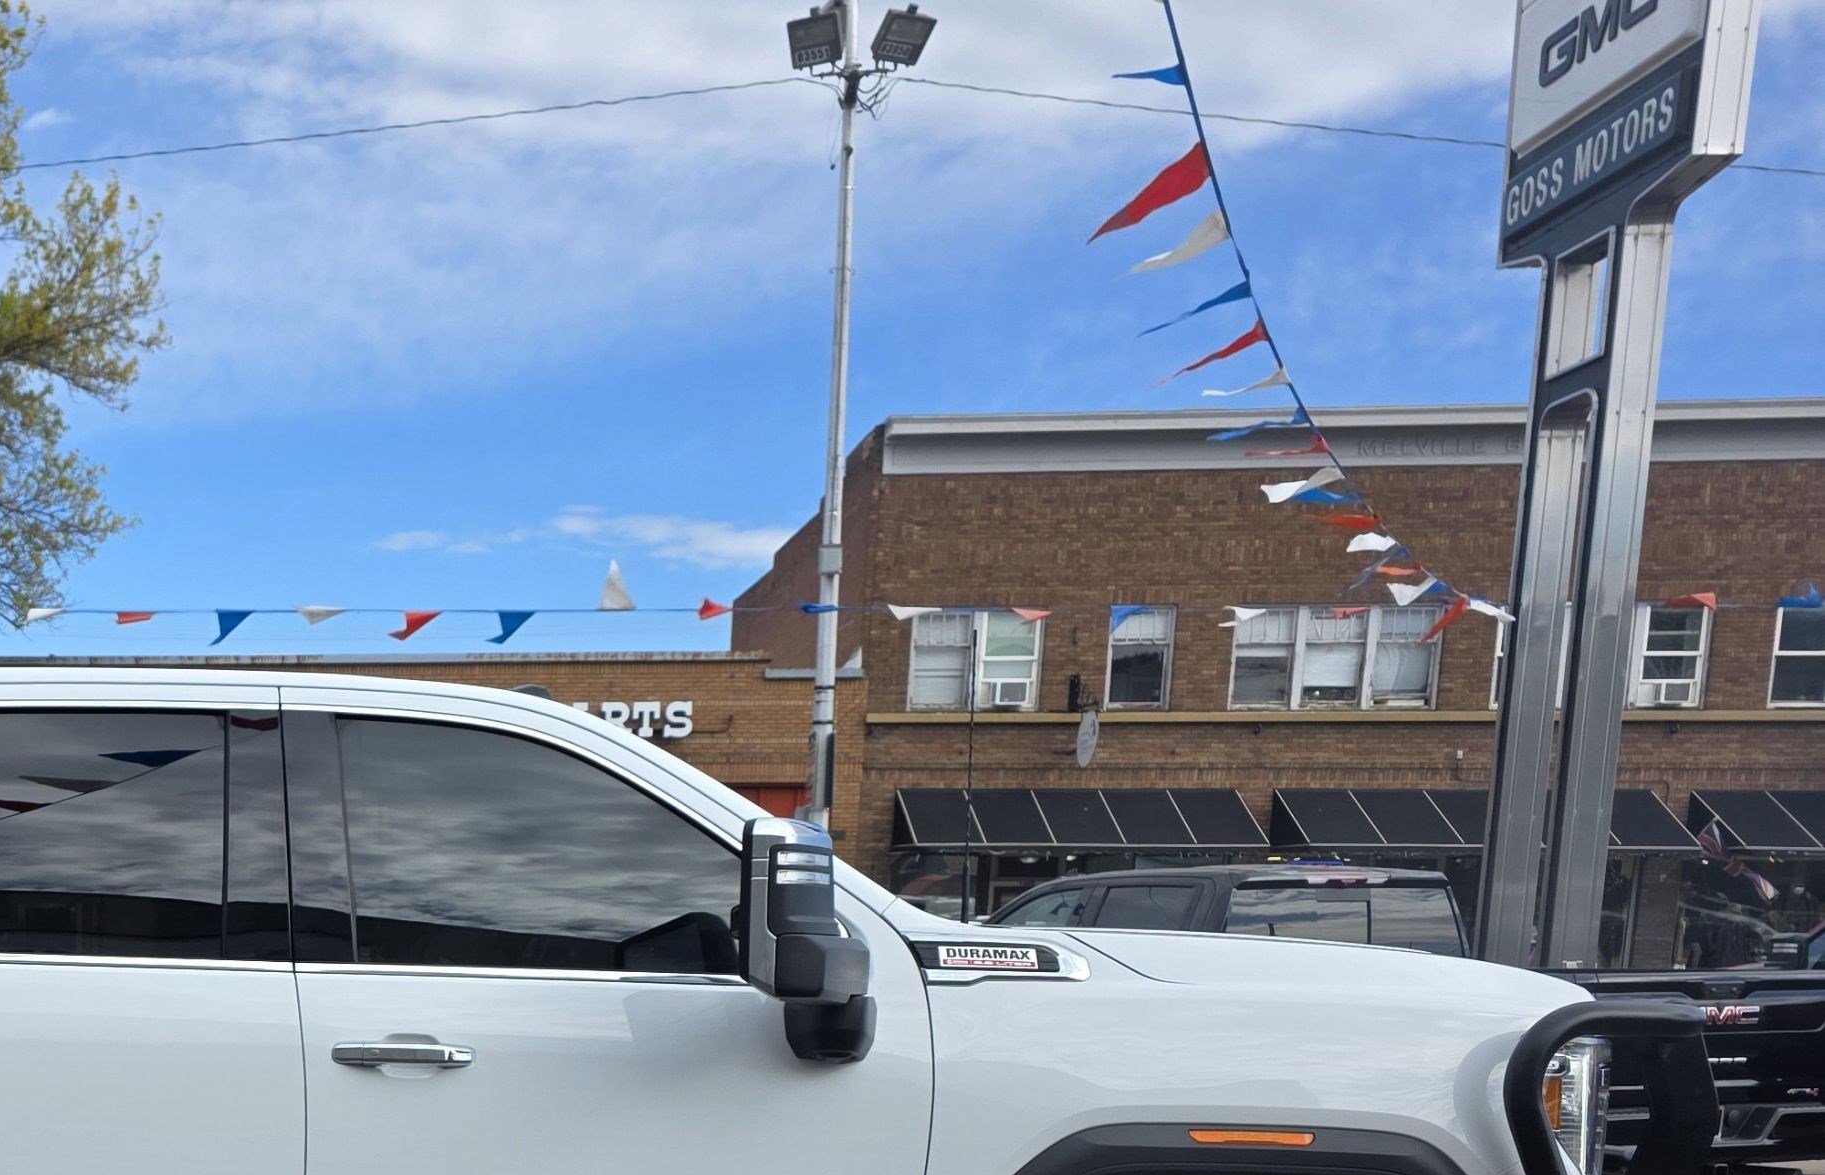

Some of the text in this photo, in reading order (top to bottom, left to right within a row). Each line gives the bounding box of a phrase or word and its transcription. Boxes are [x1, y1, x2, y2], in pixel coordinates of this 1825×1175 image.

[1506, 87, 1674, 226] GOSS MOTORS
[946, 947, 1032, 961] DURAMAX
